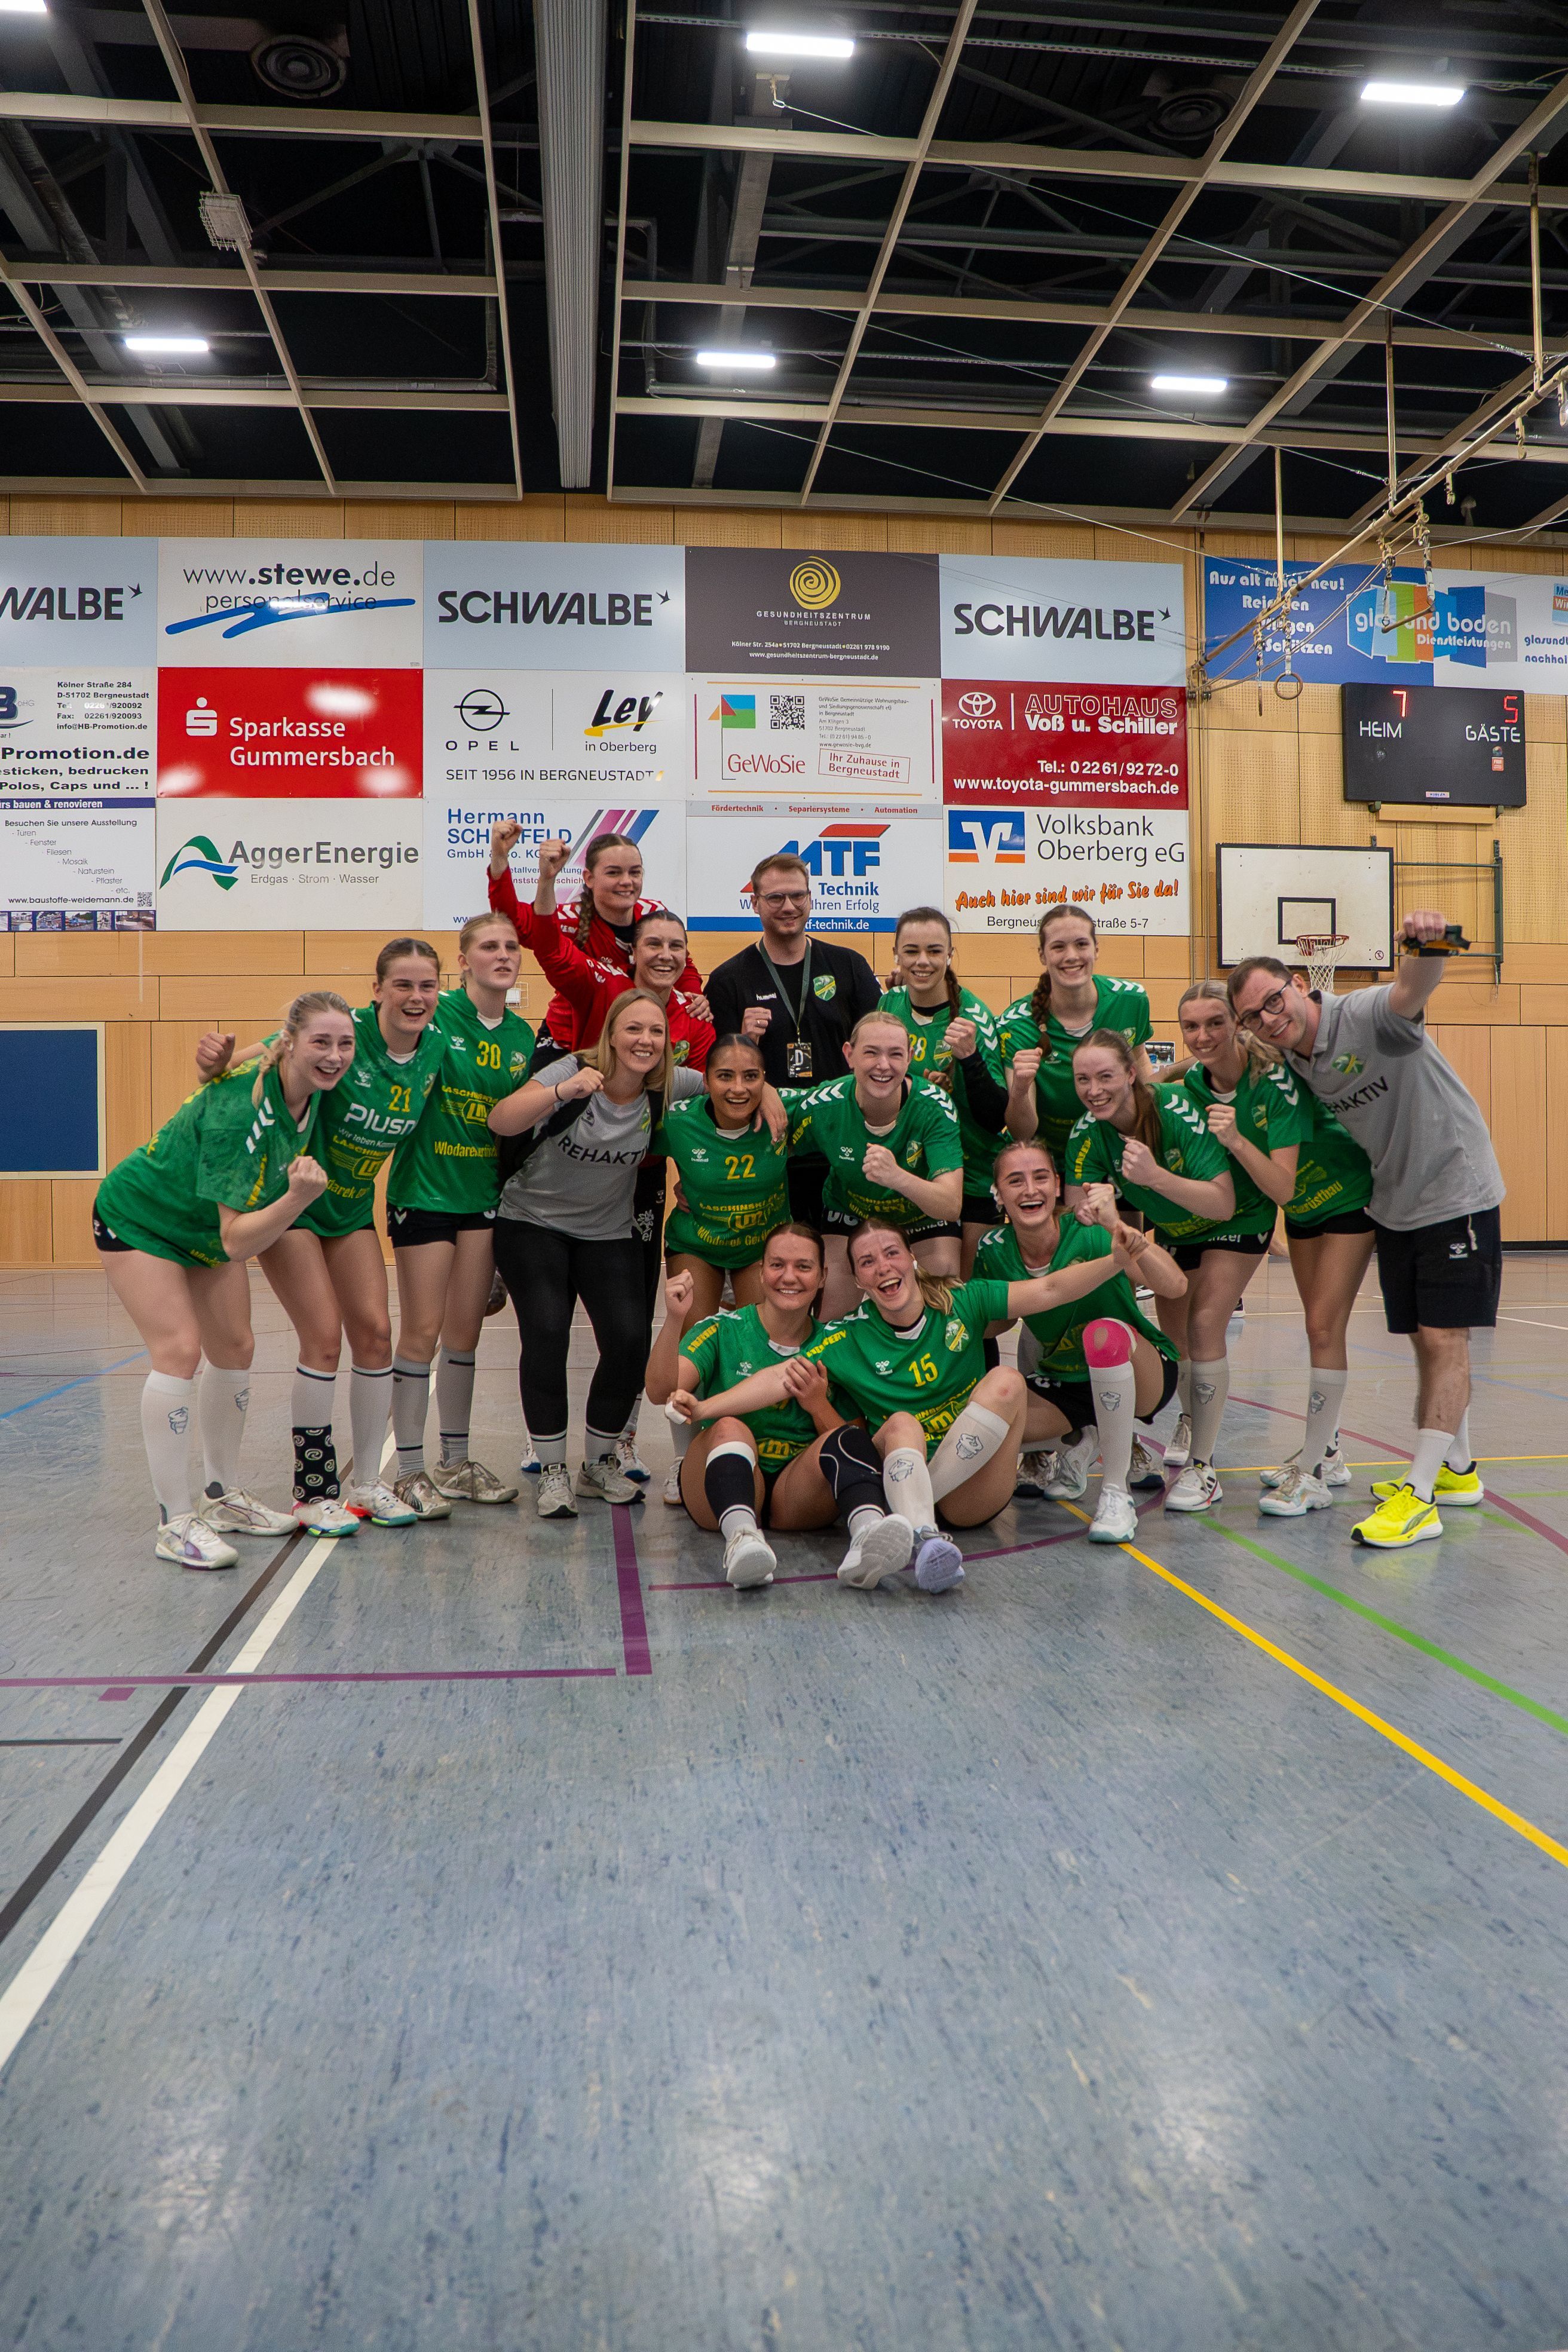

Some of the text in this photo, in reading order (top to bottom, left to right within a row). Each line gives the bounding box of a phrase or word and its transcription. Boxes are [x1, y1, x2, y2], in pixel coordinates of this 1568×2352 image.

[183, 561, 395, 586] www.stewe.de
[1209, 571, 1345, 590] Aus alt neu!
[437, 590, 653, 626] SCHWALBE
[756, 610, 871, 620] GESUNDHEITSZENTRUM
[953, 603, 1155, 642] SCHWALBE
[1404, 611, 1440, 631] und
[1447, 612, 1511, 635] boden
[1417, 634, 1511, 651] Dienstleistungen
[749, 652, 878, 660] www.gesundheitszentrum-bergneustadt.de
[591, 689, 663, 732] Ley
[1024, 694, 1178, 719] AUTOHAUS
[1392, 690, 1518, 724] 7 5
[229, 716, 346, 742] Sparkasse
[952, 713, 1178, 736] TOYOTA Voß u. Schiller
[1359, 721, 1521, 743] HEIM GÄSTE
[1, 747, 150, 760] Promotion.de
[229, 746, 395, 767] Gummersbach
[585, 742, 657, 754] in Oberberg
[727, 754, 806, 774] GeWoSie
[829, 753, 900, 768] Ihr Zuhause in
[1037, 760, 1065, 773] Tel.:
[68, 766, 149, 776] bedrucken
[446, 769, 655, 782] SEIT 1956 IN BERGNEUSTADT
[829, 762, 901, 779] Bergneustadt
[0, 781, 45, 791] Polos,
[50, 782, 88, 791] Caps
[93, 781, 120, 790] und
[145, 781, 149, 790] !
[953, 777, 1179, 795] www.toyota-gummersbach.de
[13, 800, 41, 808] bauen
[44, 800, 51, 808] &
[54, 800, 103, 808] renovieren
[789, 806, 850, 814] Separiersysteme
[448, 808, 544, 824] Hermann
[1036, 814, 1154, 837] Volksbank
[228, 840, 419, 869] AggerEnergie
[447, 849, 484, 858] GmbH
[1037, 840, 1185, 867] Oberberg eG
[251, 874, 379, 885] Erdgas Strom Wasser
[818, 881, 879, 896] Technik
[955, 879, 1179, 912] Auch hier sind wir für Sie da!
[811, 899, 880, 914] Ihren Erfolg
[1130, 918, 1149, 928] 5-7
[476, 1040, 501, 1070] 30
[388, 1085, 412, 1113] 21
[725, 1154, 756, 1180] 22
[908, 1353, 939, 1387] 15
